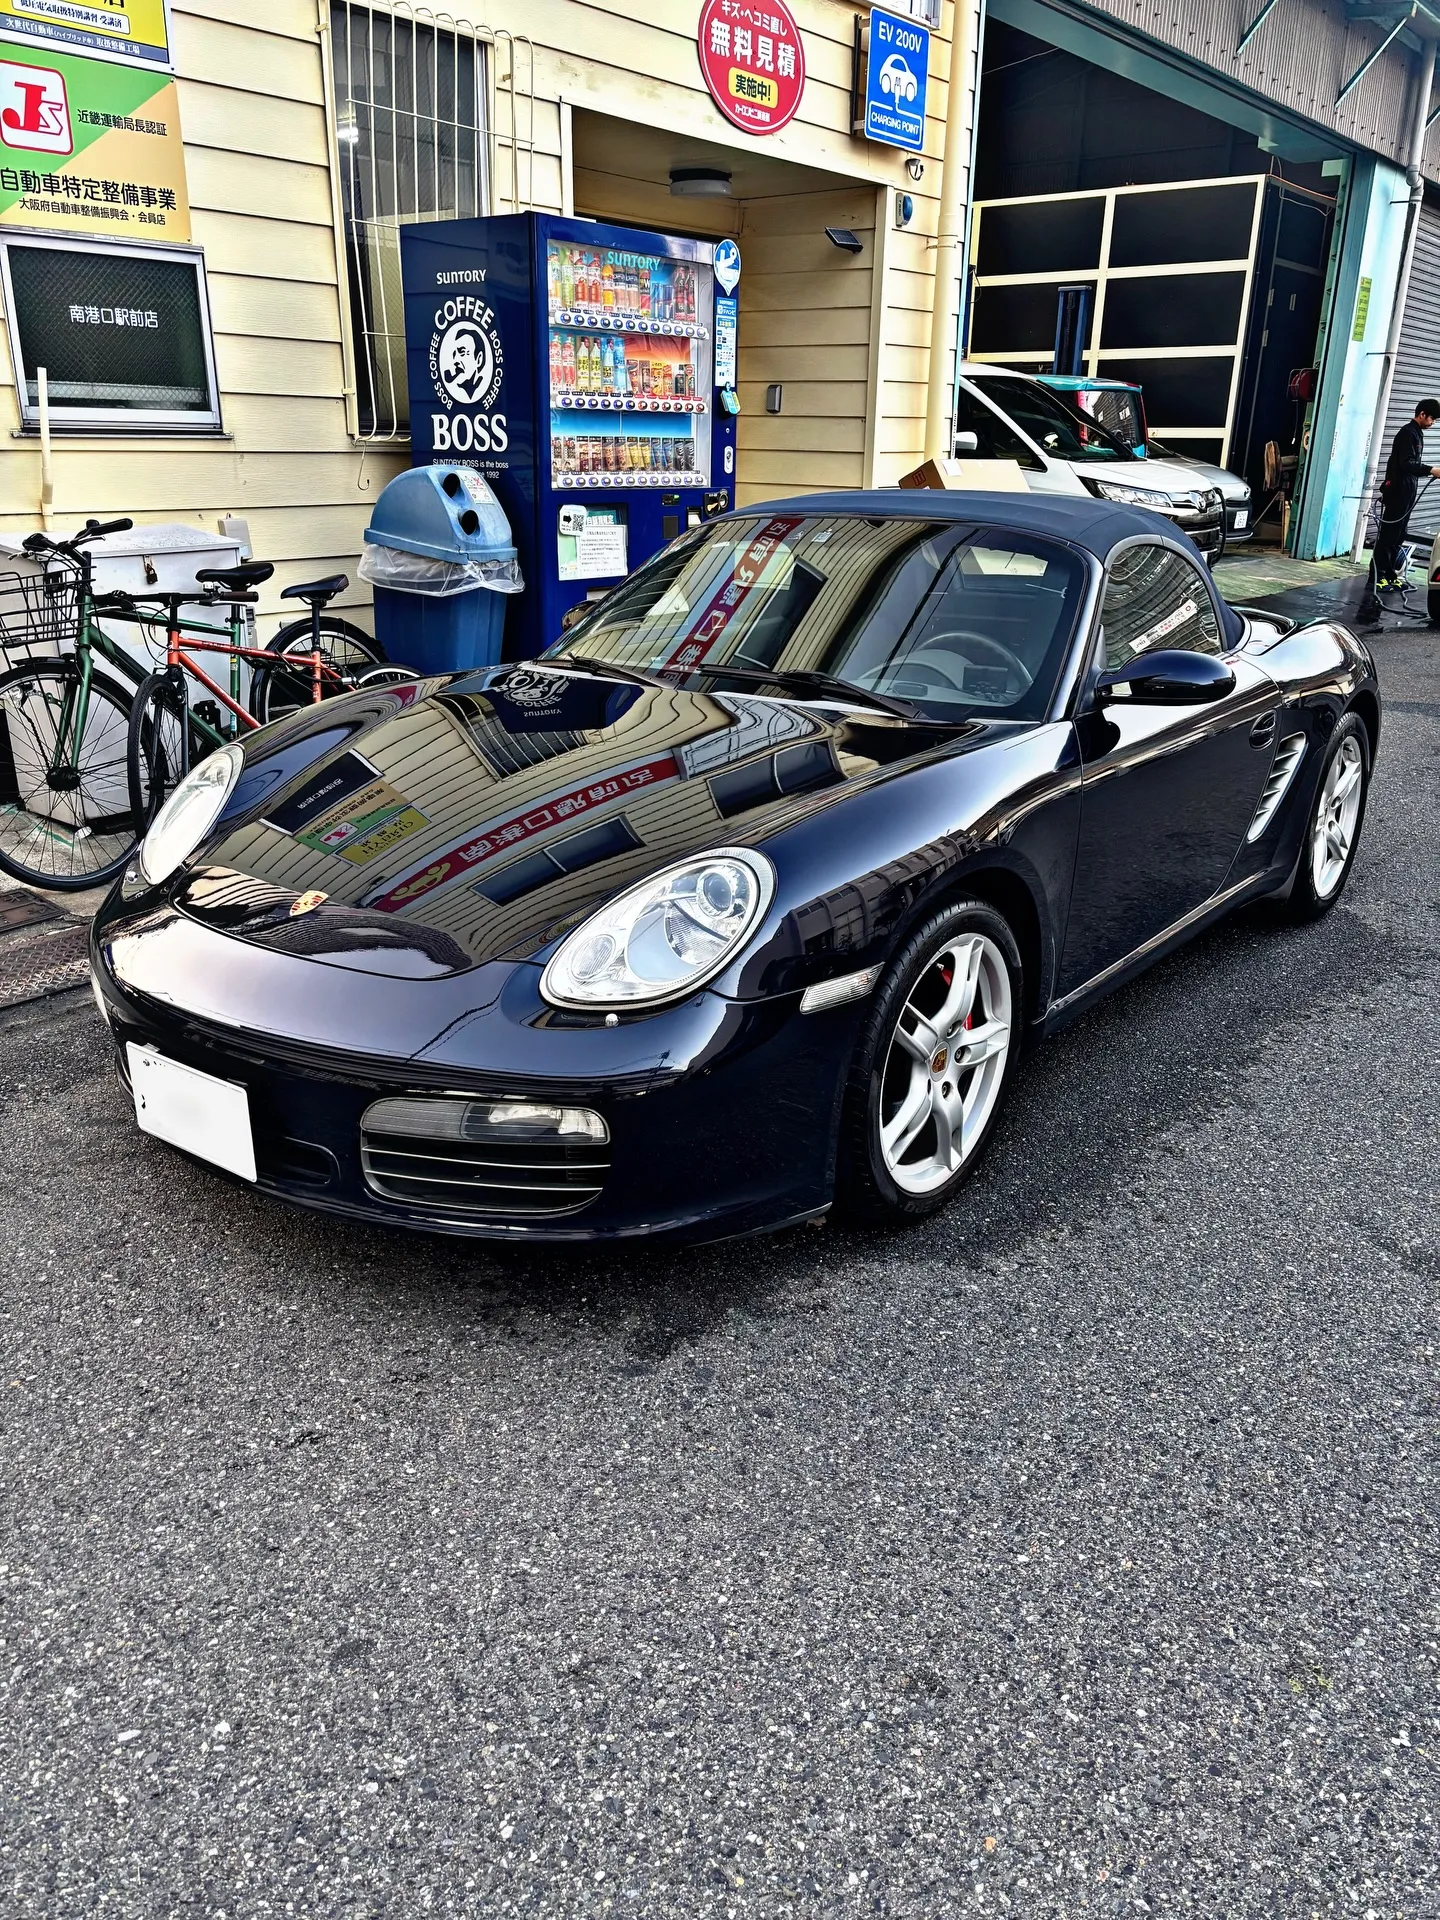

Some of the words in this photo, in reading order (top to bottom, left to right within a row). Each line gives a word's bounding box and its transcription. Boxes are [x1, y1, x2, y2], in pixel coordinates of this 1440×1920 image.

[710, 17, 796, 79] 無料見積
[878, 20, 894, 43] EV
[895, 28, 922, 54] 200V
[735, 74, 771, 101] 実施中!
[77, 108, 168, 137] 近畿運輸局長認証
[871, 111, 901, 130] CHARGING
[901, 121, 920, 135] POINT
[0, 167, 177, 211] 自動車特定整備事業
[607, 251, 661, 271] SUNTORY
[436, 269, 487, 285] SUNTORY
[69, 304, 158, 328] 南港口駅前店
[434, 296, 495, 330] COFFEE
[431, 413, 509, 452] BOSS
[486, 460, 495, 468] the
[495, 461, 509, 469] boss
[486, 471, 500, 479] 1992
